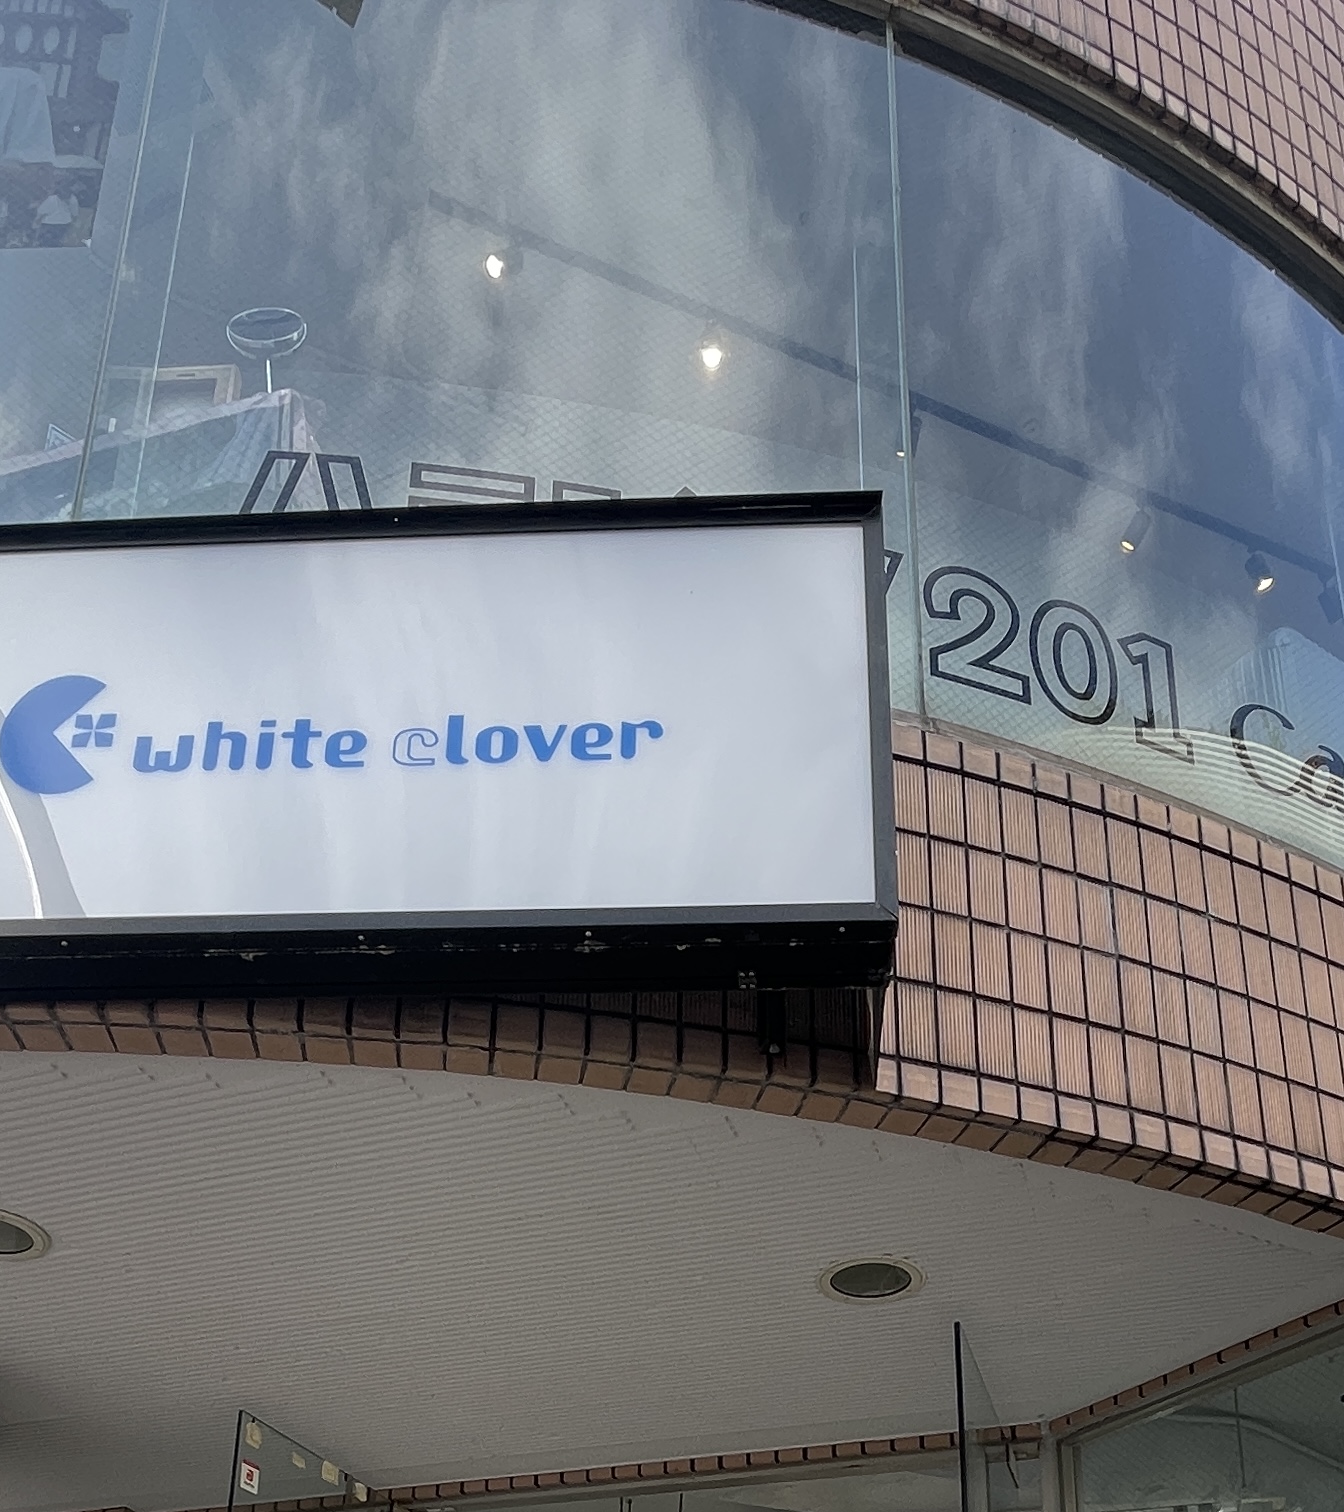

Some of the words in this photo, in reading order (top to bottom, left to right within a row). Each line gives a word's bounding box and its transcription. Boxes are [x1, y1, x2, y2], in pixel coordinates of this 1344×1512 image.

[923, 565, 1195, 765] 201
[132, 717, 367, 773] white
[391, 714, 664, 765] clover
